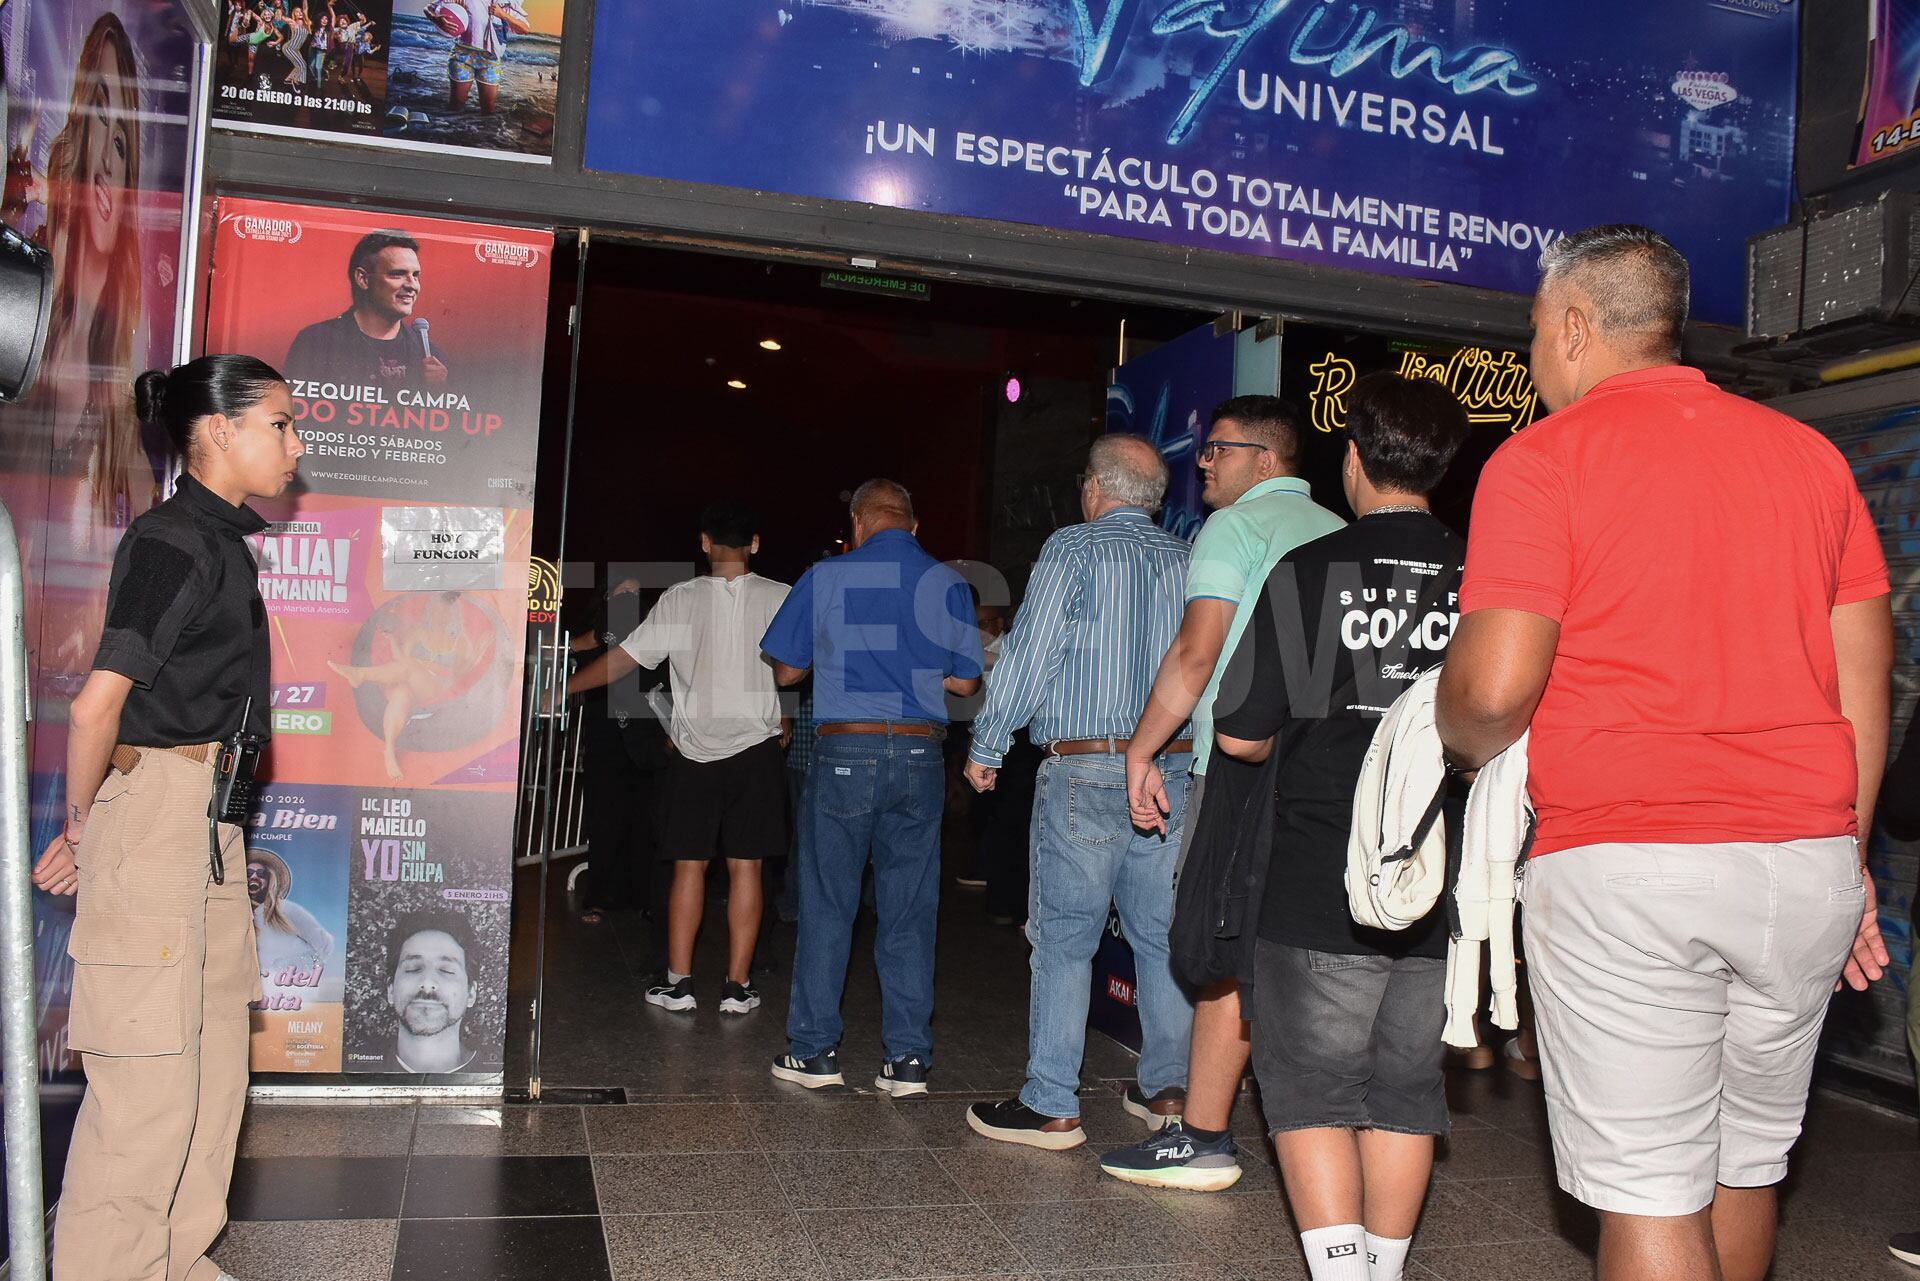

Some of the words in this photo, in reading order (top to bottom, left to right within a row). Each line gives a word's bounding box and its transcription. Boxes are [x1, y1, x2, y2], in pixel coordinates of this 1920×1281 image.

[221, 85, 237, 98] 20
[239, 88, 254, 100] de
[256, 89, 292, 105] ENERO
[294, 95, 301, 106] a
[304, 94, 322, 109] las
[324, 97, 355, 112] 21:00
[357, 101, 372, 115] hs
[1677, 86, 1693, 96] LAS
[1694, 89, 1728, 102] VEGAS
[1238, 69, 1505, 155] UNIVERSAL
[866, 120, 935, 157] ¡UN
[955, 132, 1218, 198] ESPECTÁCULO
[1228, 174, 1440, 237] TOTALMENTE
[245, 217, 292, 233] GANADOR
[1183, 203, 1272, 243] TODA
[1281, 218, 1323, 249] LA
[485, 242, 529, 258] GANADOR
[285, 379, 388, 404] ZEQUIEL
[397, 389, 471, 411] CAMPA
[347, 402, 450, 432] STAND
[462, 411, 503, 437] UP
[297, 430, 345, 443] TODOS
[350, 434, 376, 446] LOS
[380, 434, 442, 451] SÁBADOS
[305, 444, 314, 455] E
[319, 445, 367, 458] ENERO
[372, 449, 380, 459] Y
[385, 450, 446, 465] FEBRERO
[270, 522, 319, 533] PERIENCIA
[431, 533, 462, 543] HOY
[413, 549, 480, 559] FUNCION
[1400, 560, 1427, 568] SUMMER
[283, 605, 315, 613] Mariela
[318, 606, 350, 614] Asensio
[529, 611, 556, 623] EDY
[1381, 663, 1424, 680] Timele
[286, 686, 315, 703] 27
[278, 795, 305, 804] 2026
[362, 798, 381, 811] LIC.
[383, 799, 411, 817] LEO
[271, 807, 338, 830] Bien
[360, 817, 427, 838] MAIELLO
[260, 832, 293, 841] CUMPLE
[402, 840, 426, 861] SIN
[360, 839, 400, 882] YO
[401, 862, 444, 883] CULPA
[454, 891, 482, 899] ENERO
[273, 964, 325, 988] del
[1110, 979, 1129, 1002] AKAI
[287, 1021, 324, 1035] MELANY
[353, 1053, 384, 1062] Plateanet
[1155, 1143, 1195, 1161] FILA
